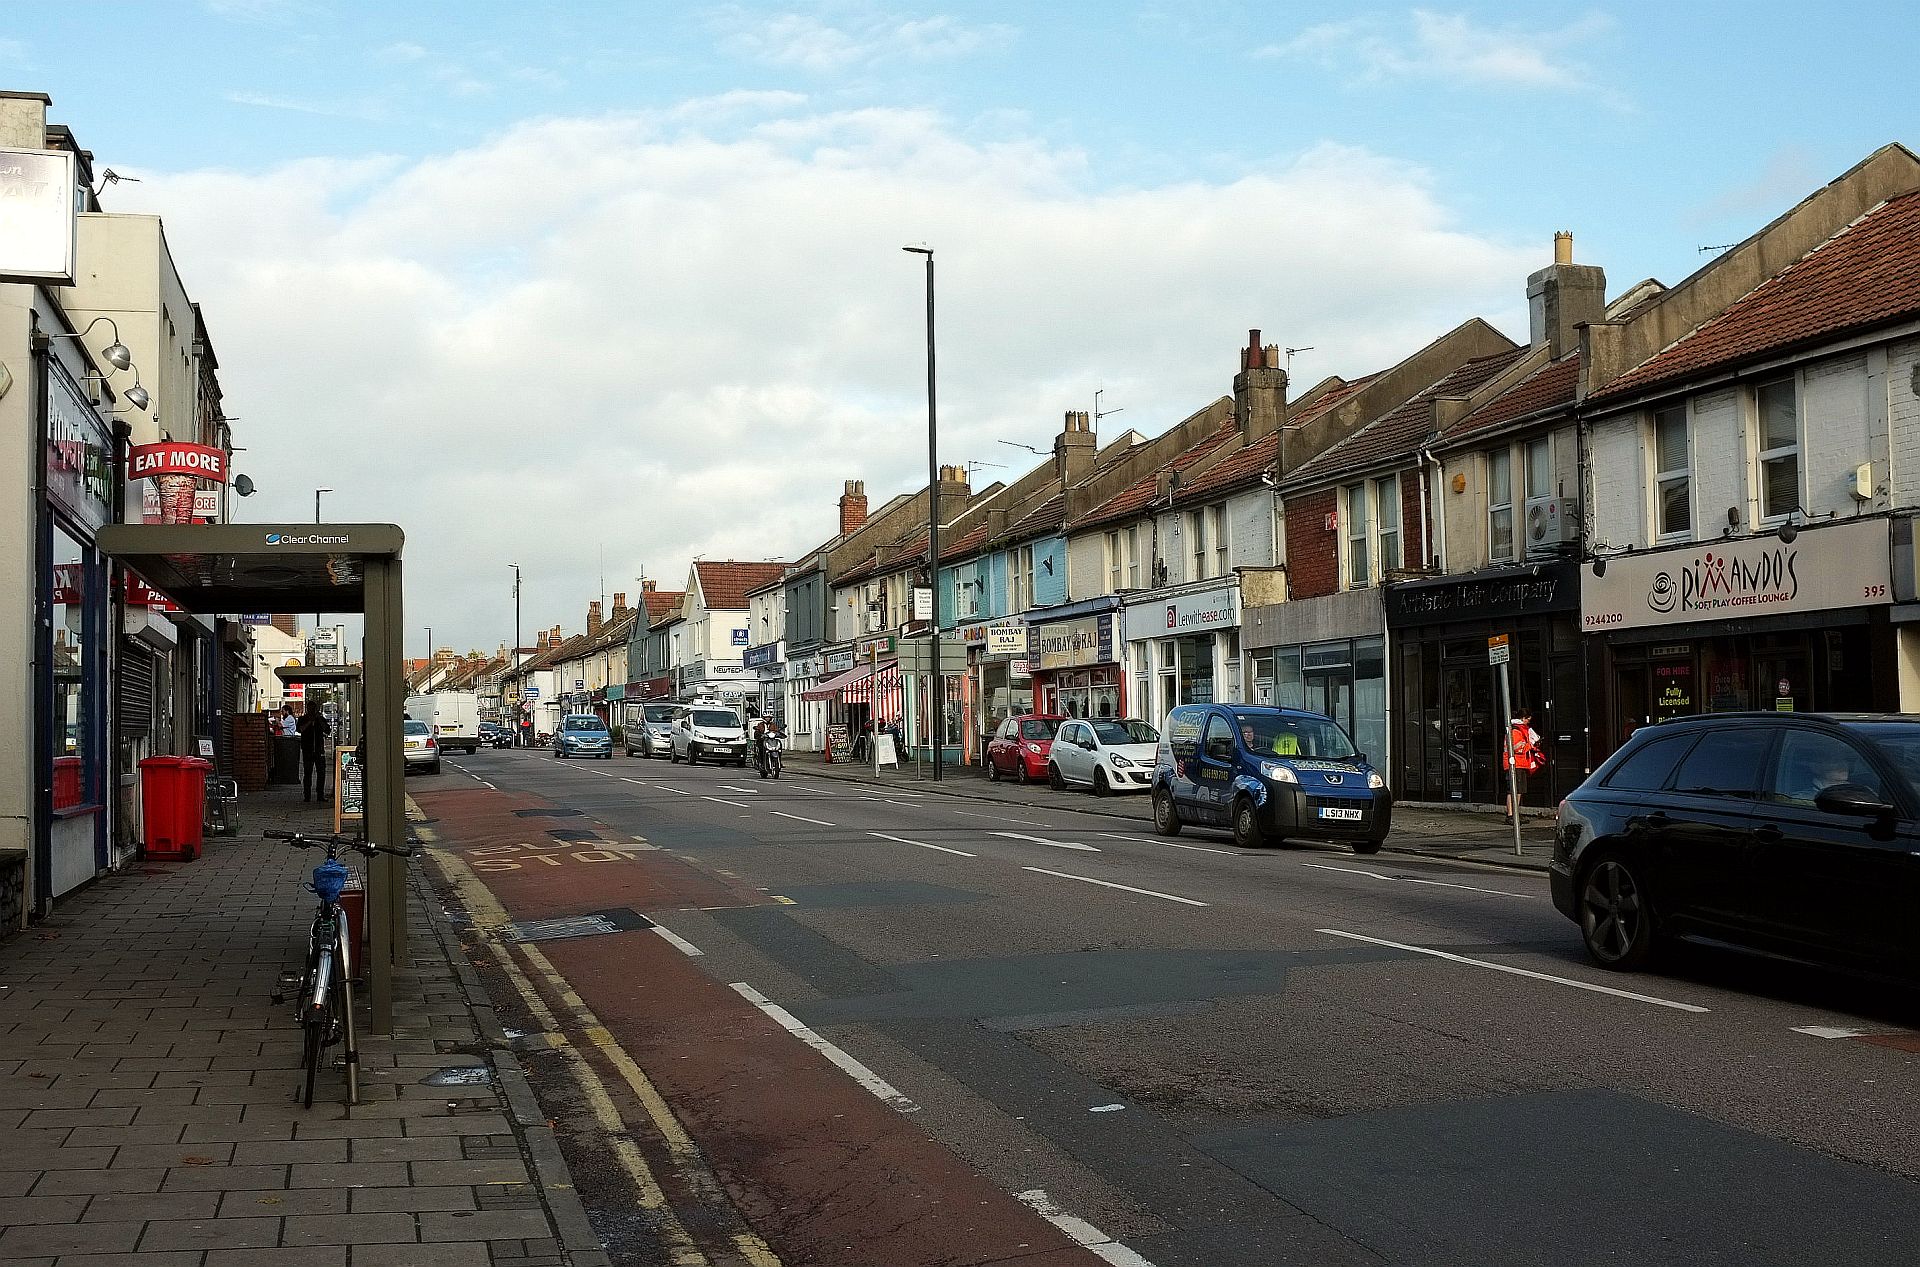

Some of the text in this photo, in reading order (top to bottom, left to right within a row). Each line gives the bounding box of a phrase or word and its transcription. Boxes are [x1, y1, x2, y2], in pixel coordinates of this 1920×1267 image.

[136, 451, 220, 473] EAT MORE
[194, 498, 216, 510] ORE
[281, 534, 349, 544] Clear Channel
[1398, 579, 1558, 614] Artistic Hair Company
[1864, 585, 1885, 598] 395
[1694, 593, 1789, 610] SOFT PLAY COFFEE LOUNGE
[1178, 607, 1235, 627] Letwithease.com
[1585, 613, 1623, 626] 9244200
[991, 628, 1023, 636] BOMBAY
[1041, 635, 1072, 654] BOMBAY
[1081, 631, 1097, 649] RAJ
[713, 665, 744, 674] NEWTECH
[1656, 666, 1690, 676] FOR HIRE
[1665, 687, 1682, 698] Fully
[1658, 695, 1690, 706] Licensed
[1325, 808, 1360, 819] LS13 NHX
